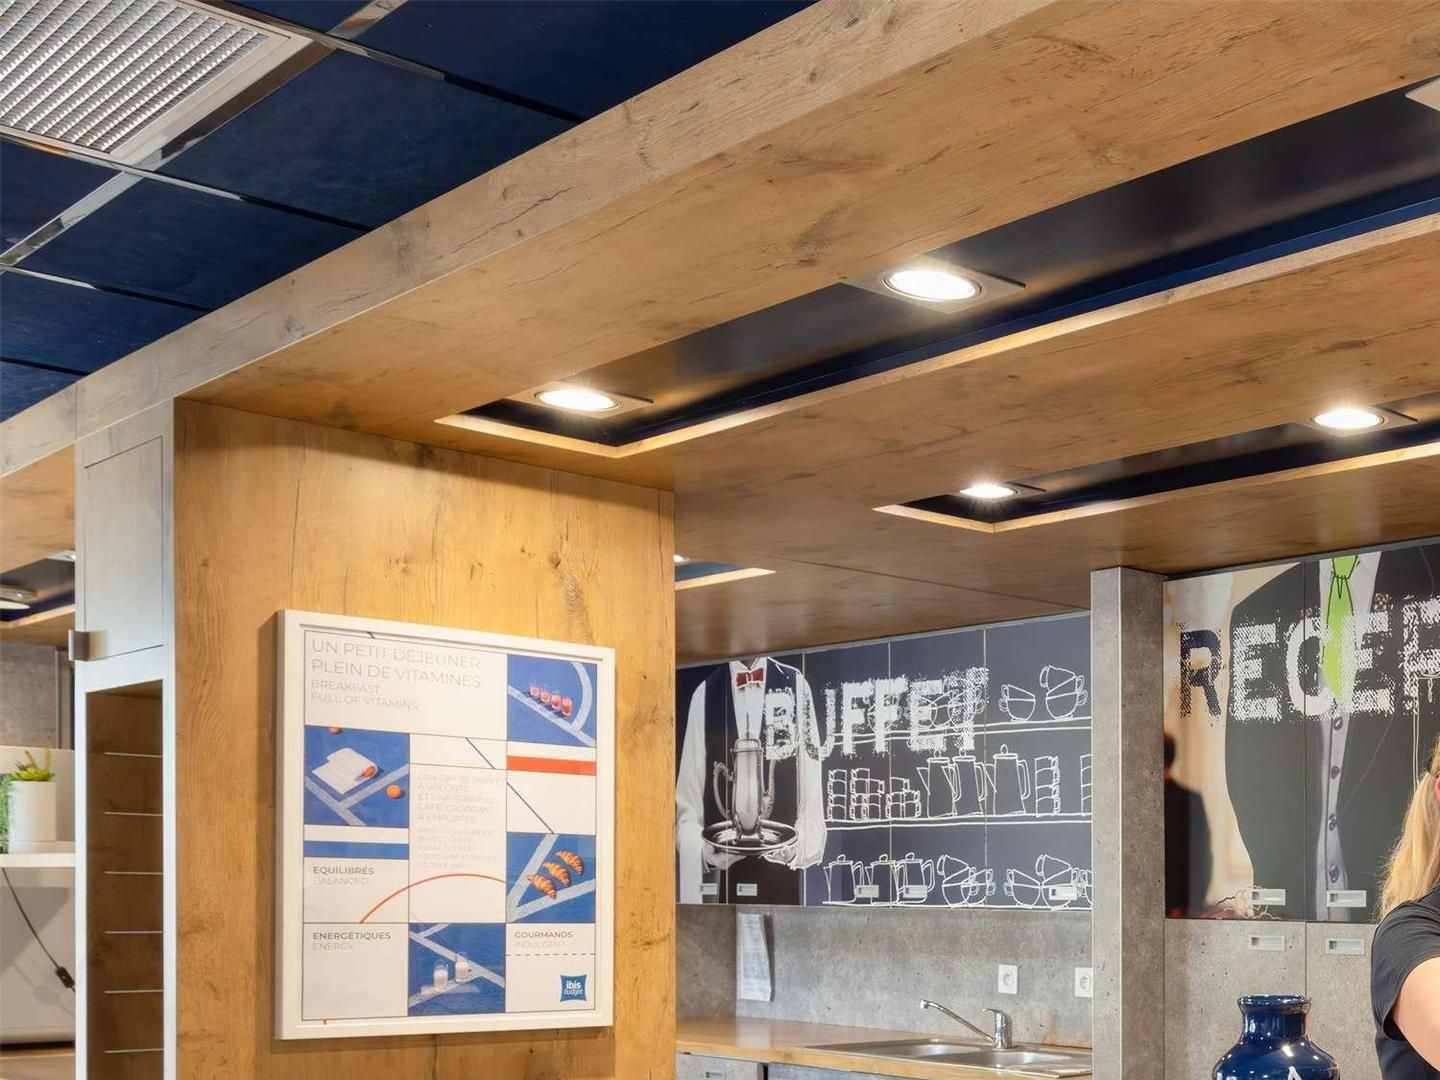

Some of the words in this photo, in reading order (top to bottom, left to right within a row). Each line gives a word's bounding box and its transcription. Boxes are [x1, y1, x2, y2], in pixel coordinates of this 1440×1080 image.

[312, 639, 338, 654] UN
[343, 643, 387, 659] PETIT
[312, 659, 362, 676] PLEIN
[368, 664, 392, 679] DE
[393, 667, 482, 688] VITAMINES
[764, 666, 989, 759] BUFFET
[566, 980, 582, 989] ibis
